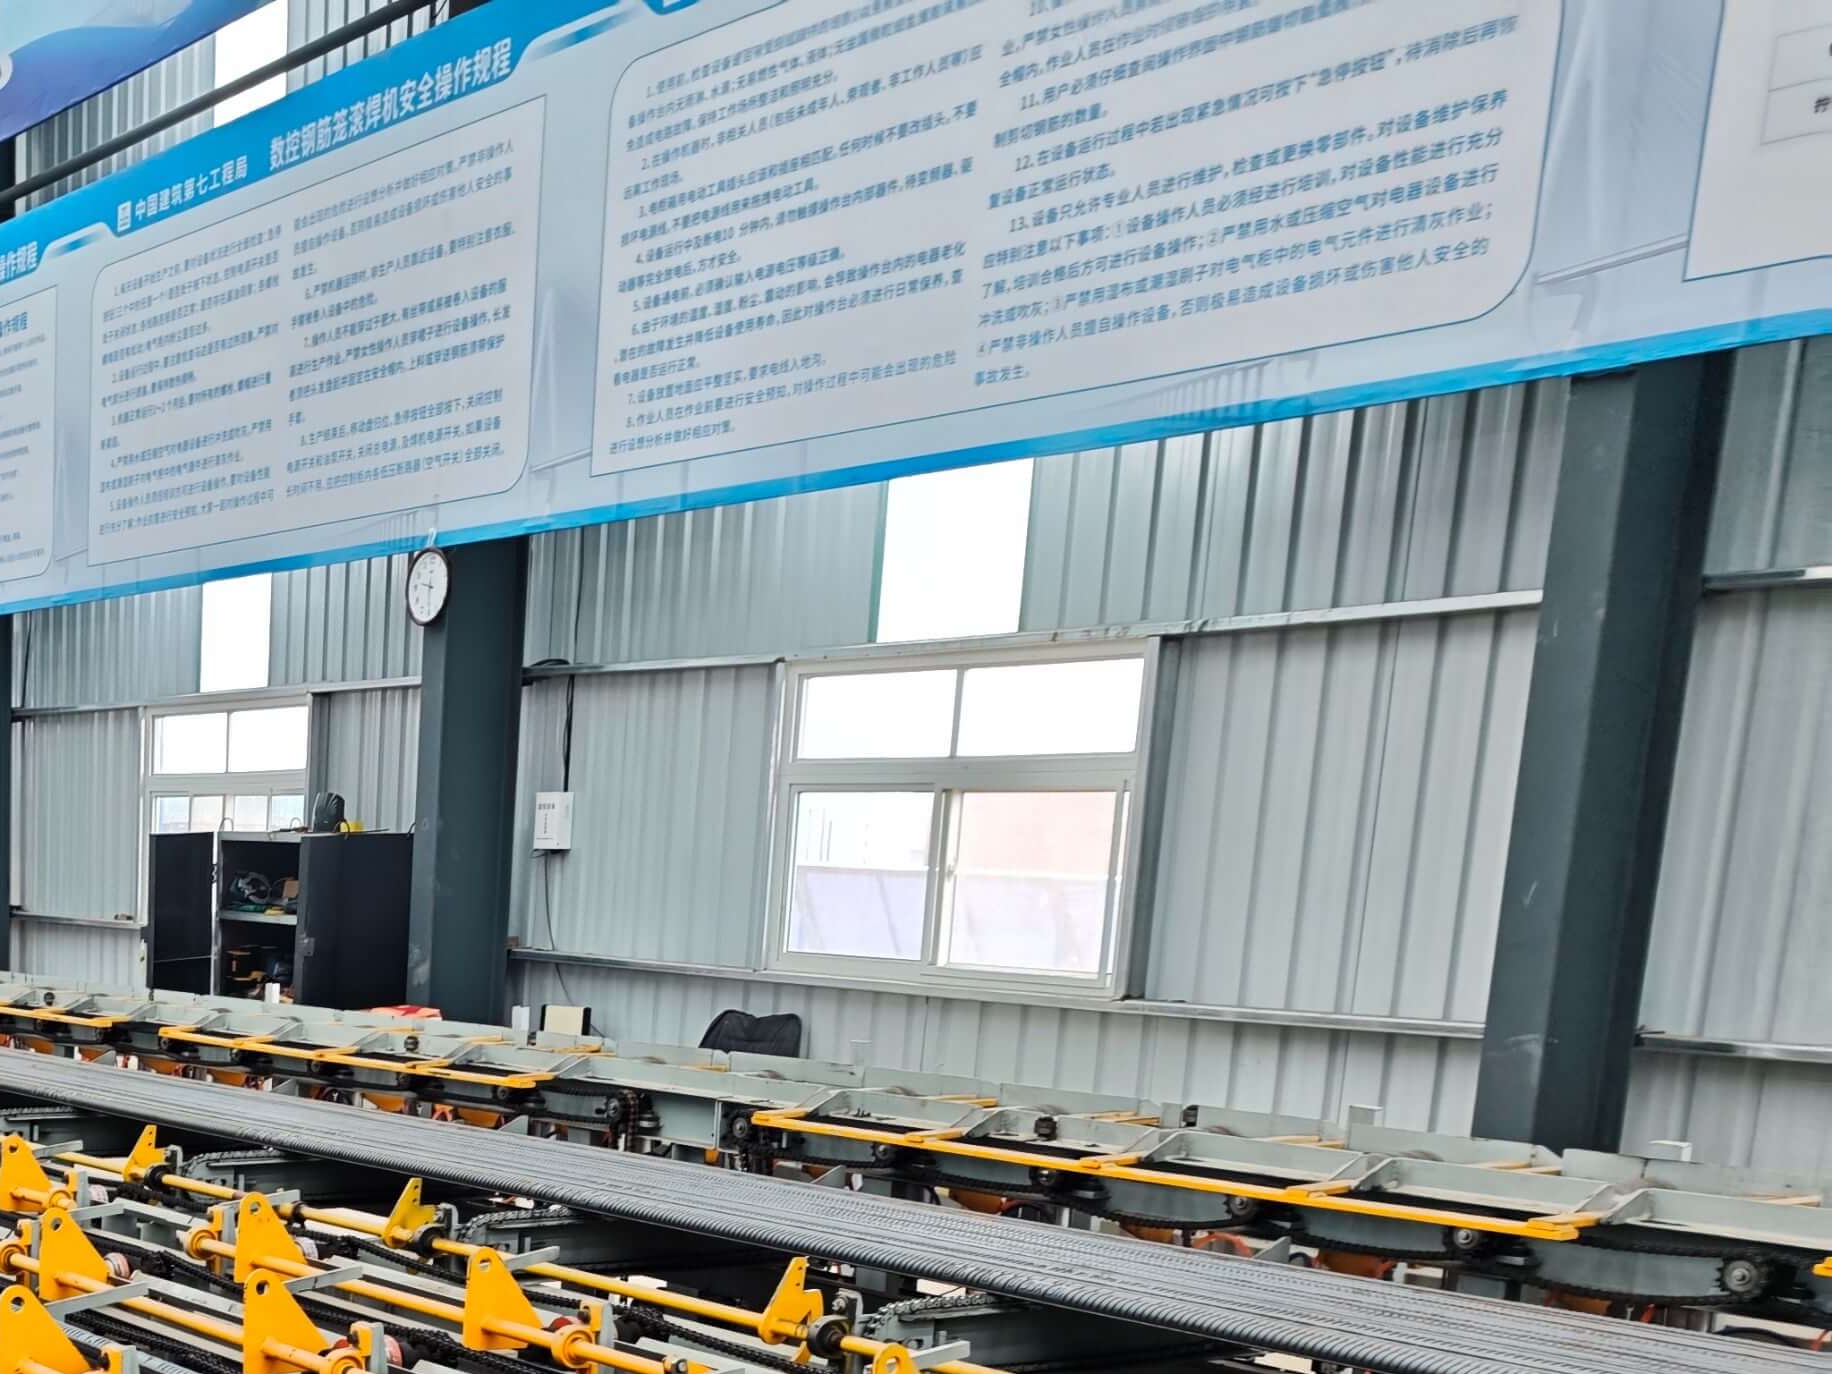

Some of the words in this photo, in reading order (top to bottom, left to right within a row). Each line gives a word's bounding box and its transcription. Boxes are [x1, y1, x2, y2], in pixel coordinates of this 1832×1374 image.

[134, 154, 249, 223] 中国建筑第七工程局
[268, 38, 513, 173] 数控钢筋笼滚焊机安全操作规程
